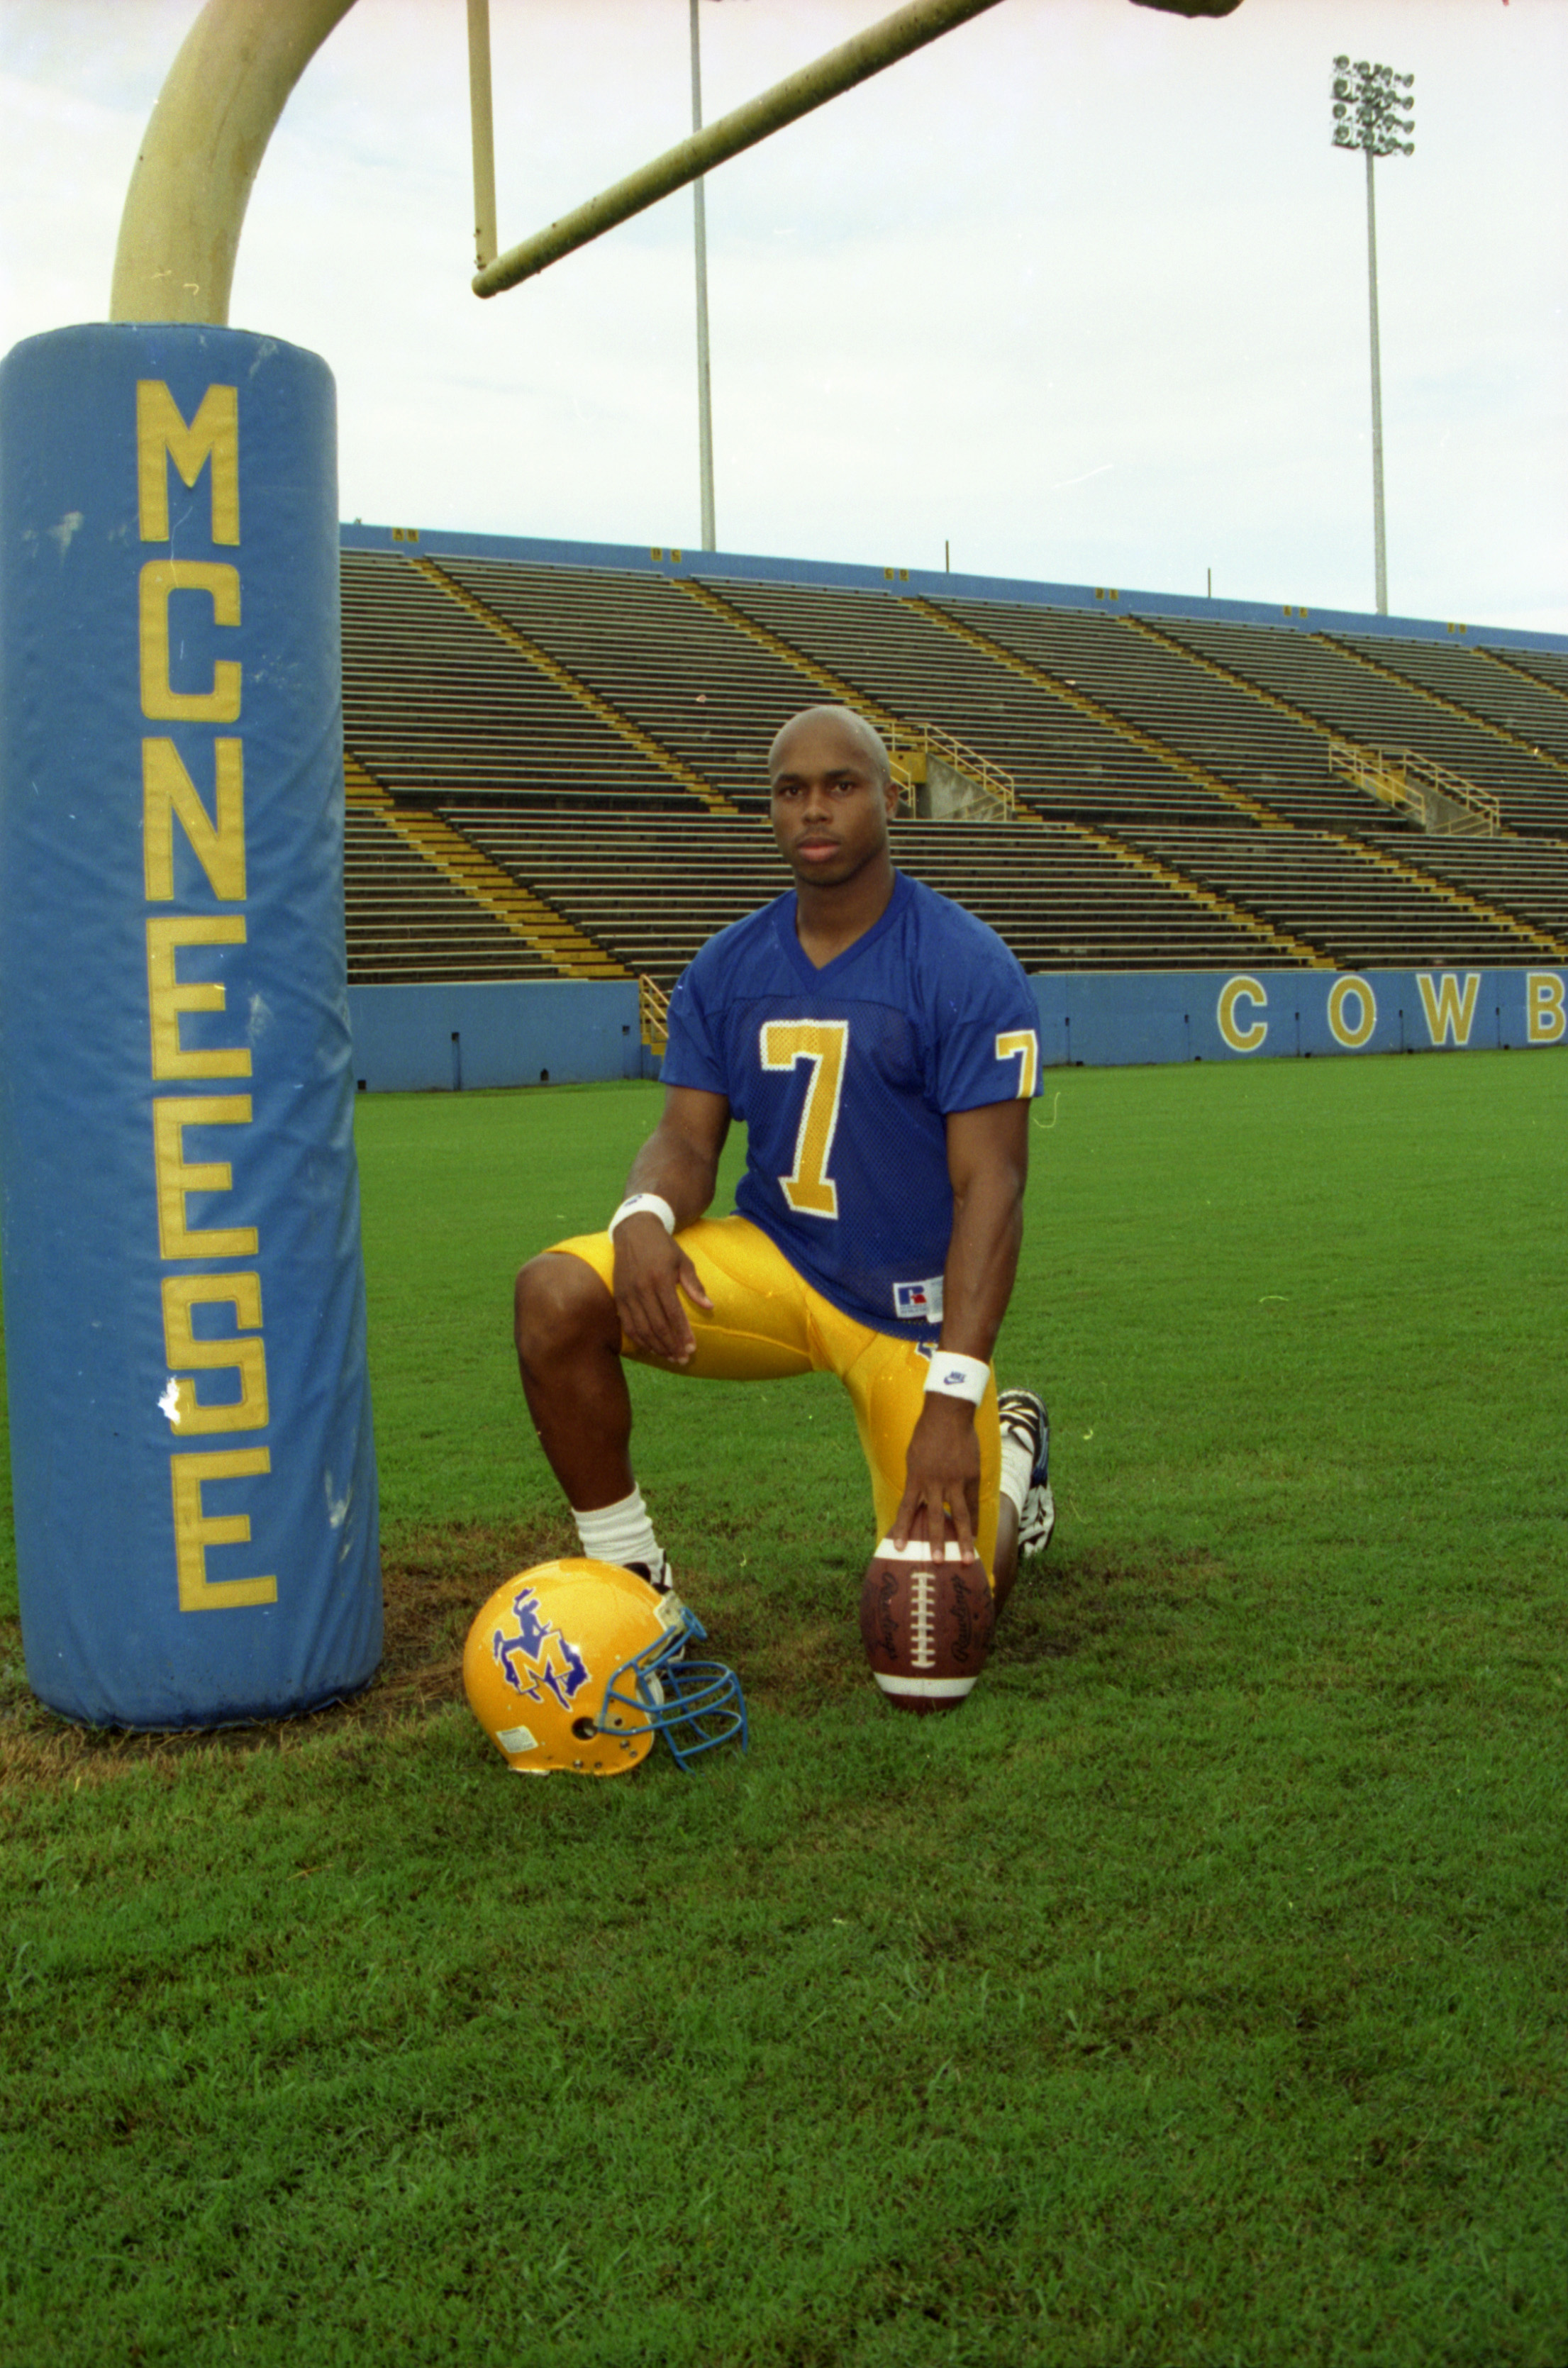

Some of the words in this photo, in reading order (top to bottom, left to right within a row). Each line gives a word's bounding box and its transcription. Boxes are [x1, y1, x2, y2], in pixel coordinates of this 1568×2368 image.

[136, 379, 278, 1612] MCNEESE
[996, 1029, 1038, 1099] 7
[760, 1019, 848, 1219] 7
